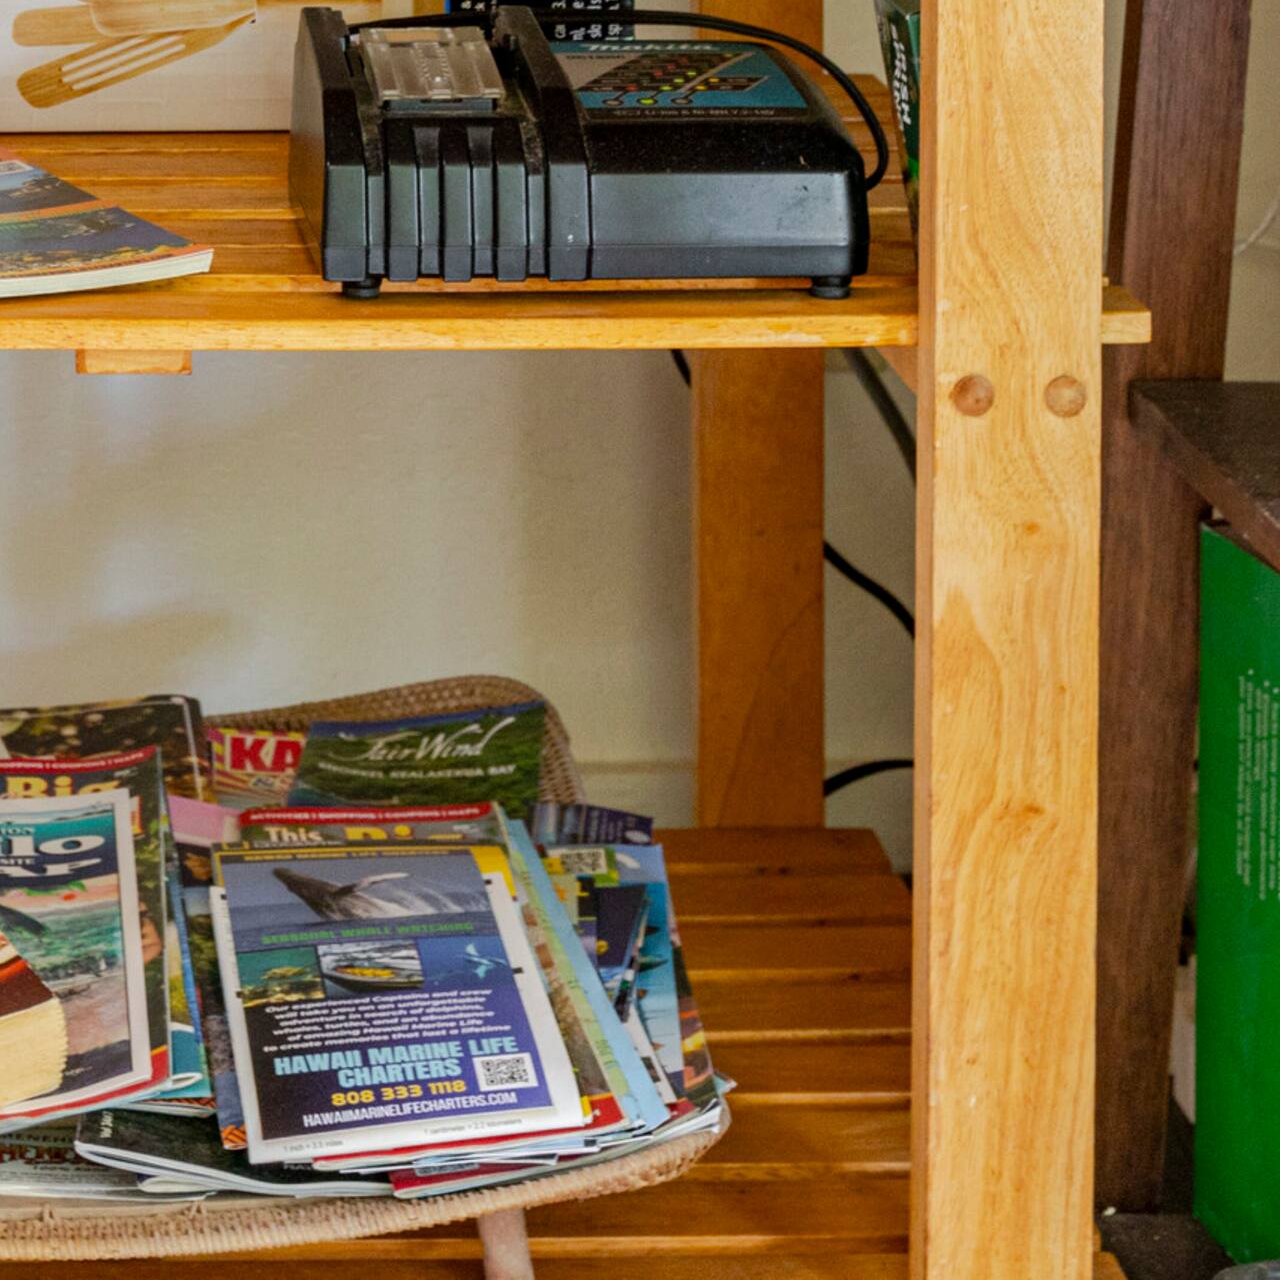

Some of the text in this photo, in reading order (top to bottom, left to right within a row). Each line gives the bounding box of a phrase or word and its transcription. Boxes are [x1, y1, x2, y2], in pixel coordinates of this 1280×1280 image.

[462, 0, 471, 10] &
[264, 826, 323, 842] This
[291, 998, 370, 1010] experienced
[372, 993, 429, 1003] Captains
[280, 1042, 322, 1050] create
[324, 1035, 389, 1045] memories
[273, 1036, 519, 1077] HAWAII MARINE LIFE
[337, 1058, 462, 1089] CHARTERS
[330, 1079, 467, 1108] 808 333 1118
[302, 1091, 518, 1128] HAWAIIMARINELIFECHARTERS.COM
